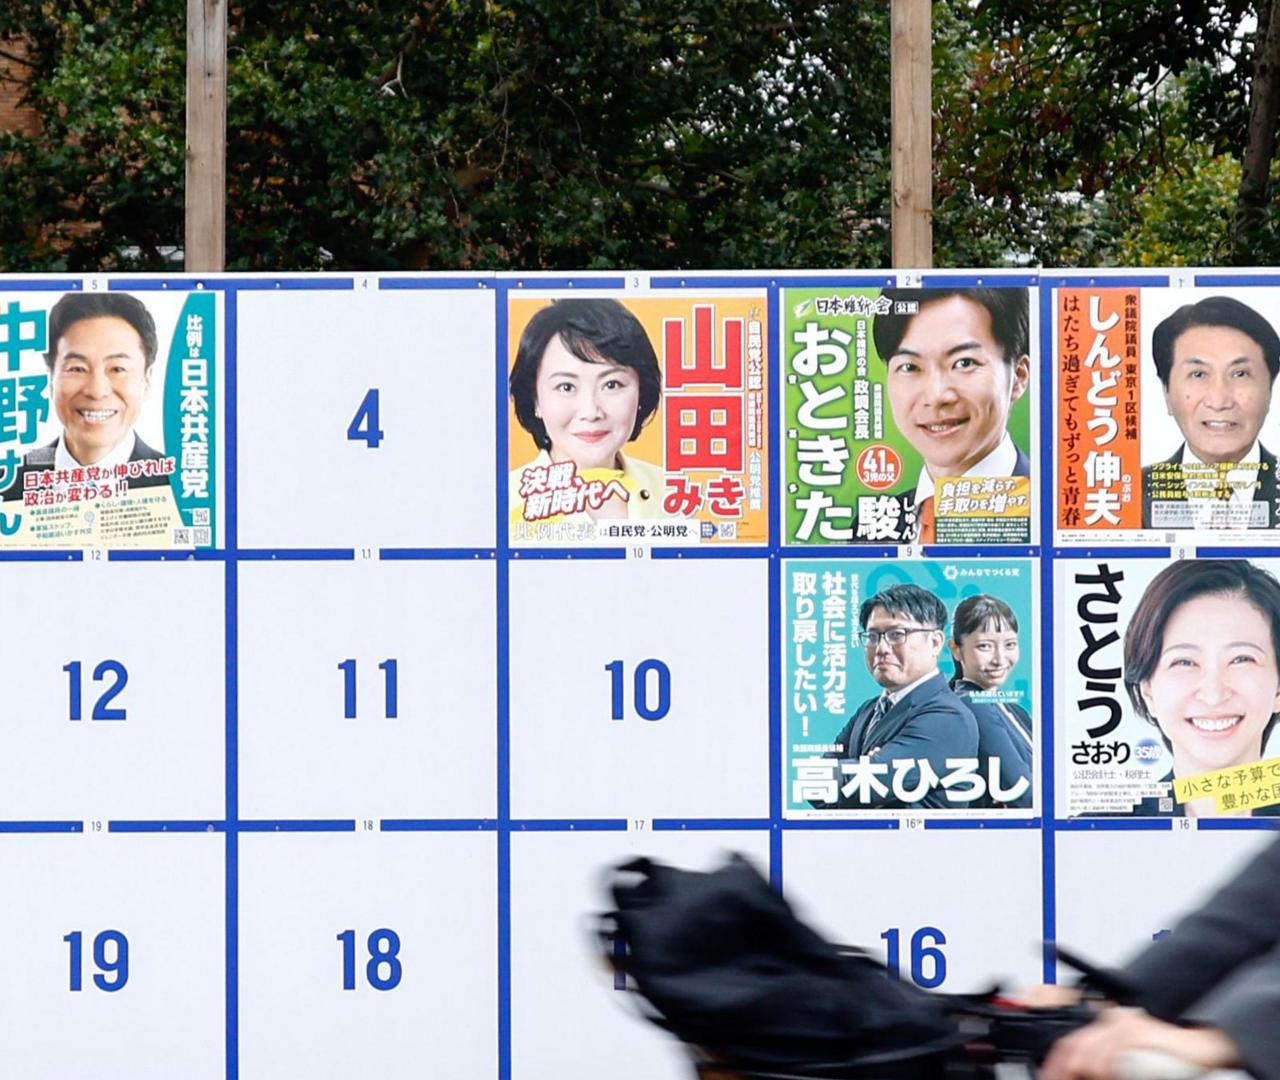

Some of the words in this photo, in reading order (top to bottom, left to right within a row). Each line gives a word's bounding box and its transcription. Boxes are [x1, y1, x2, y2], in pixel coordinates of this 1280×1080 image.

[92, 279, 98, 290] 5
[362, 278, 368, 289] 4
[634, 277, 639, 288] 3
[905, 275, 911, 286] 2
[1124, 294, 1138, 358] 衆議院議員
[663, 304, 745, 474] 山田
[1083, 294, 1122, 446] しんどう
[180, 314, 209, 498] 比例は日本共産党
[347, 388, 384, 448] 4
[1061, 296, 1081, 526] はたち過ぎてもずっと青春
[791, 322, 854, 541] おときた
[24, 460, 175, 490] 日本共産党が伸びれば
[663, 476, 744, 518] みき
[1083, 450, 1121, 525] 伸夫
[523, 479, 631, 522] 新時代へ
[856, 495, 902, 541] 駿
[902, 496, 918, 541] しゅん
[90, 549, 101, 560] 12
[633, 547, 644, 559] 10
[906, 546, 912, 557] 9
[821, 571, 847, 715] 社会に活力を
[1074, 563, 1125, 739] さとう
[63, 659, 128, 721] 12
[338, 658, 398, 719] 11
[606, 658, 671, 721] 10
[1071, 740, 1131, 765] さおり
[791, 755, 1031, 804] 高木ひろし
[91, 820, 102, 831] 19
[363, 819, 374, 831] 18
[634, 819, 645, 831] 17
[63, 930, 129, 992] 19
[337, 928, 402, 990] 18
[881, 926, 947, 989] 16
